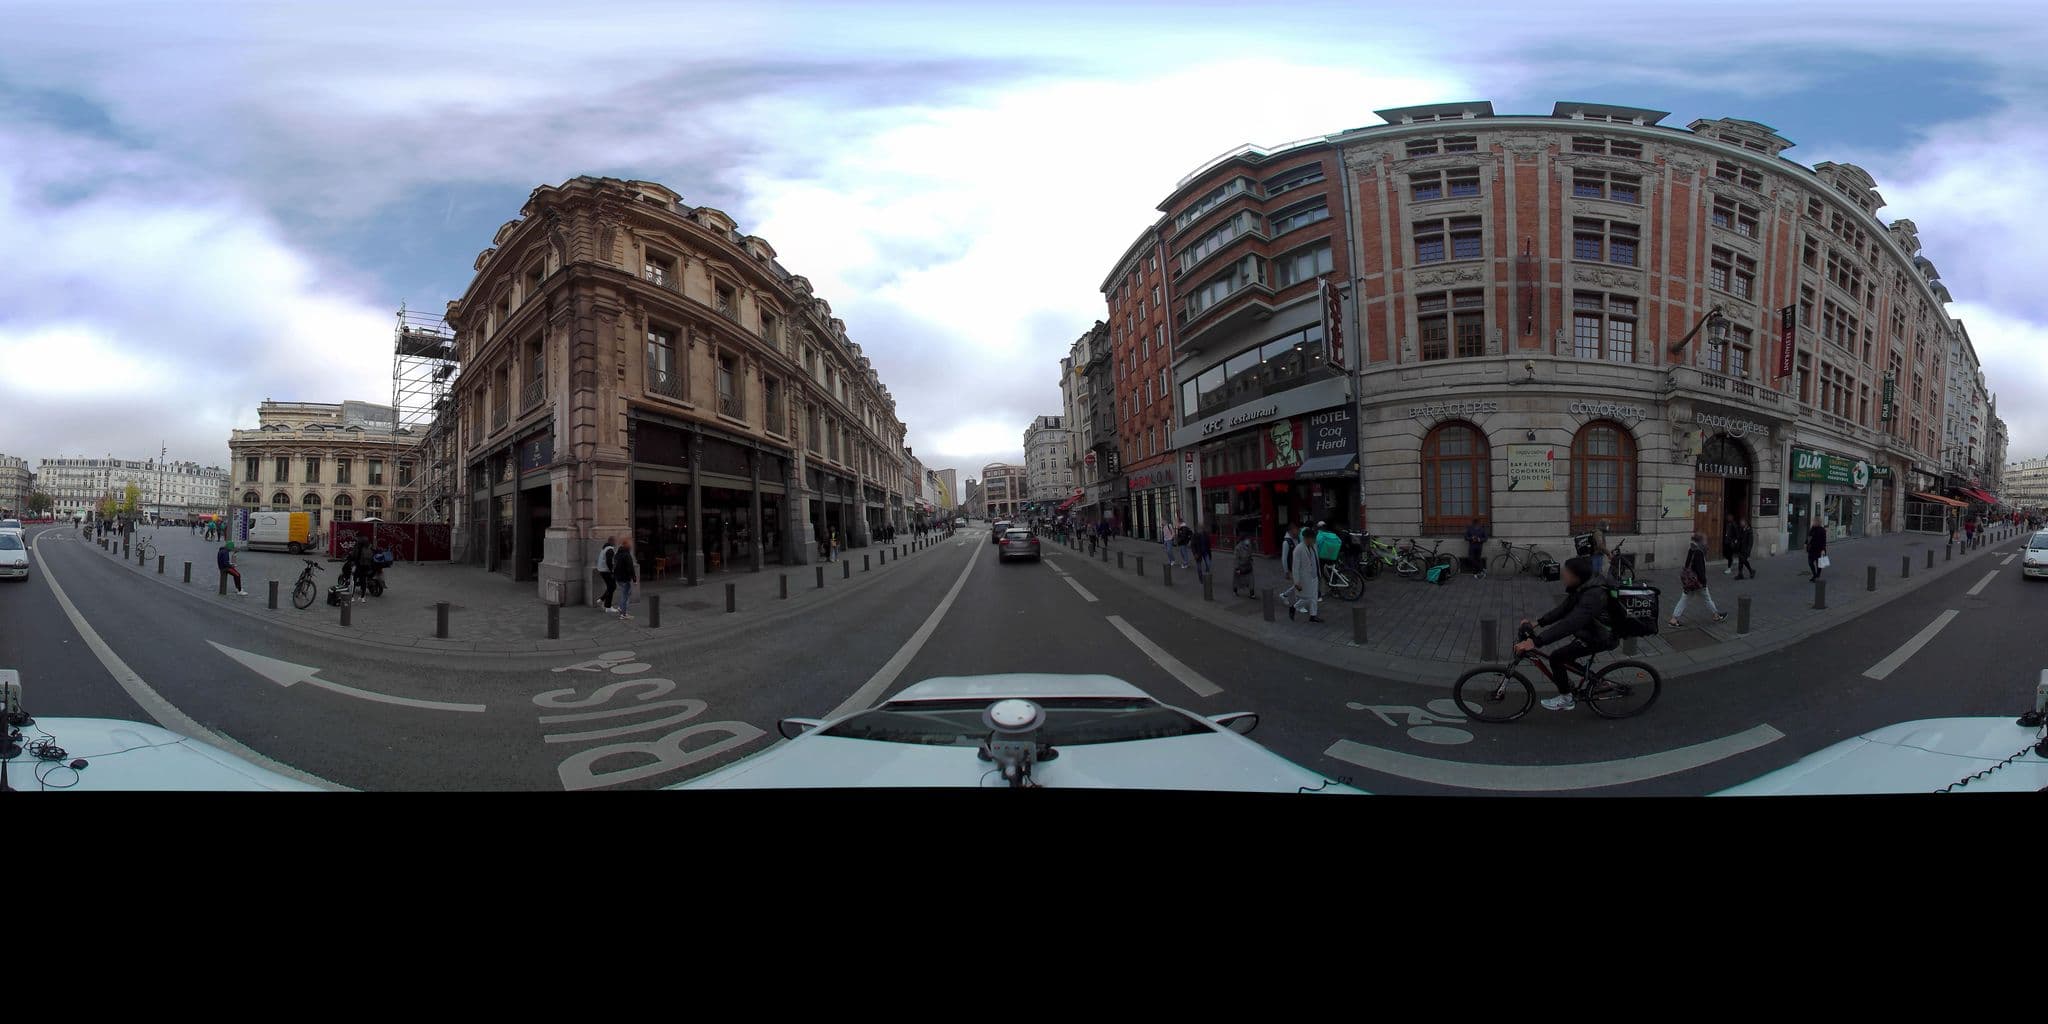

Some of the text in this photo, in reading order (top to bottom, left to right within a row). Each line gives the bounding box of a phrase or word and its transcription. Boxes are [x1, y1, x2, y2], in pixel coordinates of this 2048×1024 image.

[1229, 405, 1278, 427] Restaurant
[1311, 410, 1351, 426] HOTEL
[1409, 406, 1435, 418] BAR
[1569, 402, 1648, 421] COWORKING
[1201, 419, 1224, 436] KFC
[1319, 427, 1342, 438] Coq
[1316, 437, 1347, 451] Hardi
[1798, 453, 1822, 469] DLM
[1698, 463, 1748, 475] RESTAURANT
[1873, 466, 1889, 475] DLM
[1626, 597, 1653, 608] Uber
[1626, 608, 1652, 618] Eats
[531, 677, 767, 792] BUS
